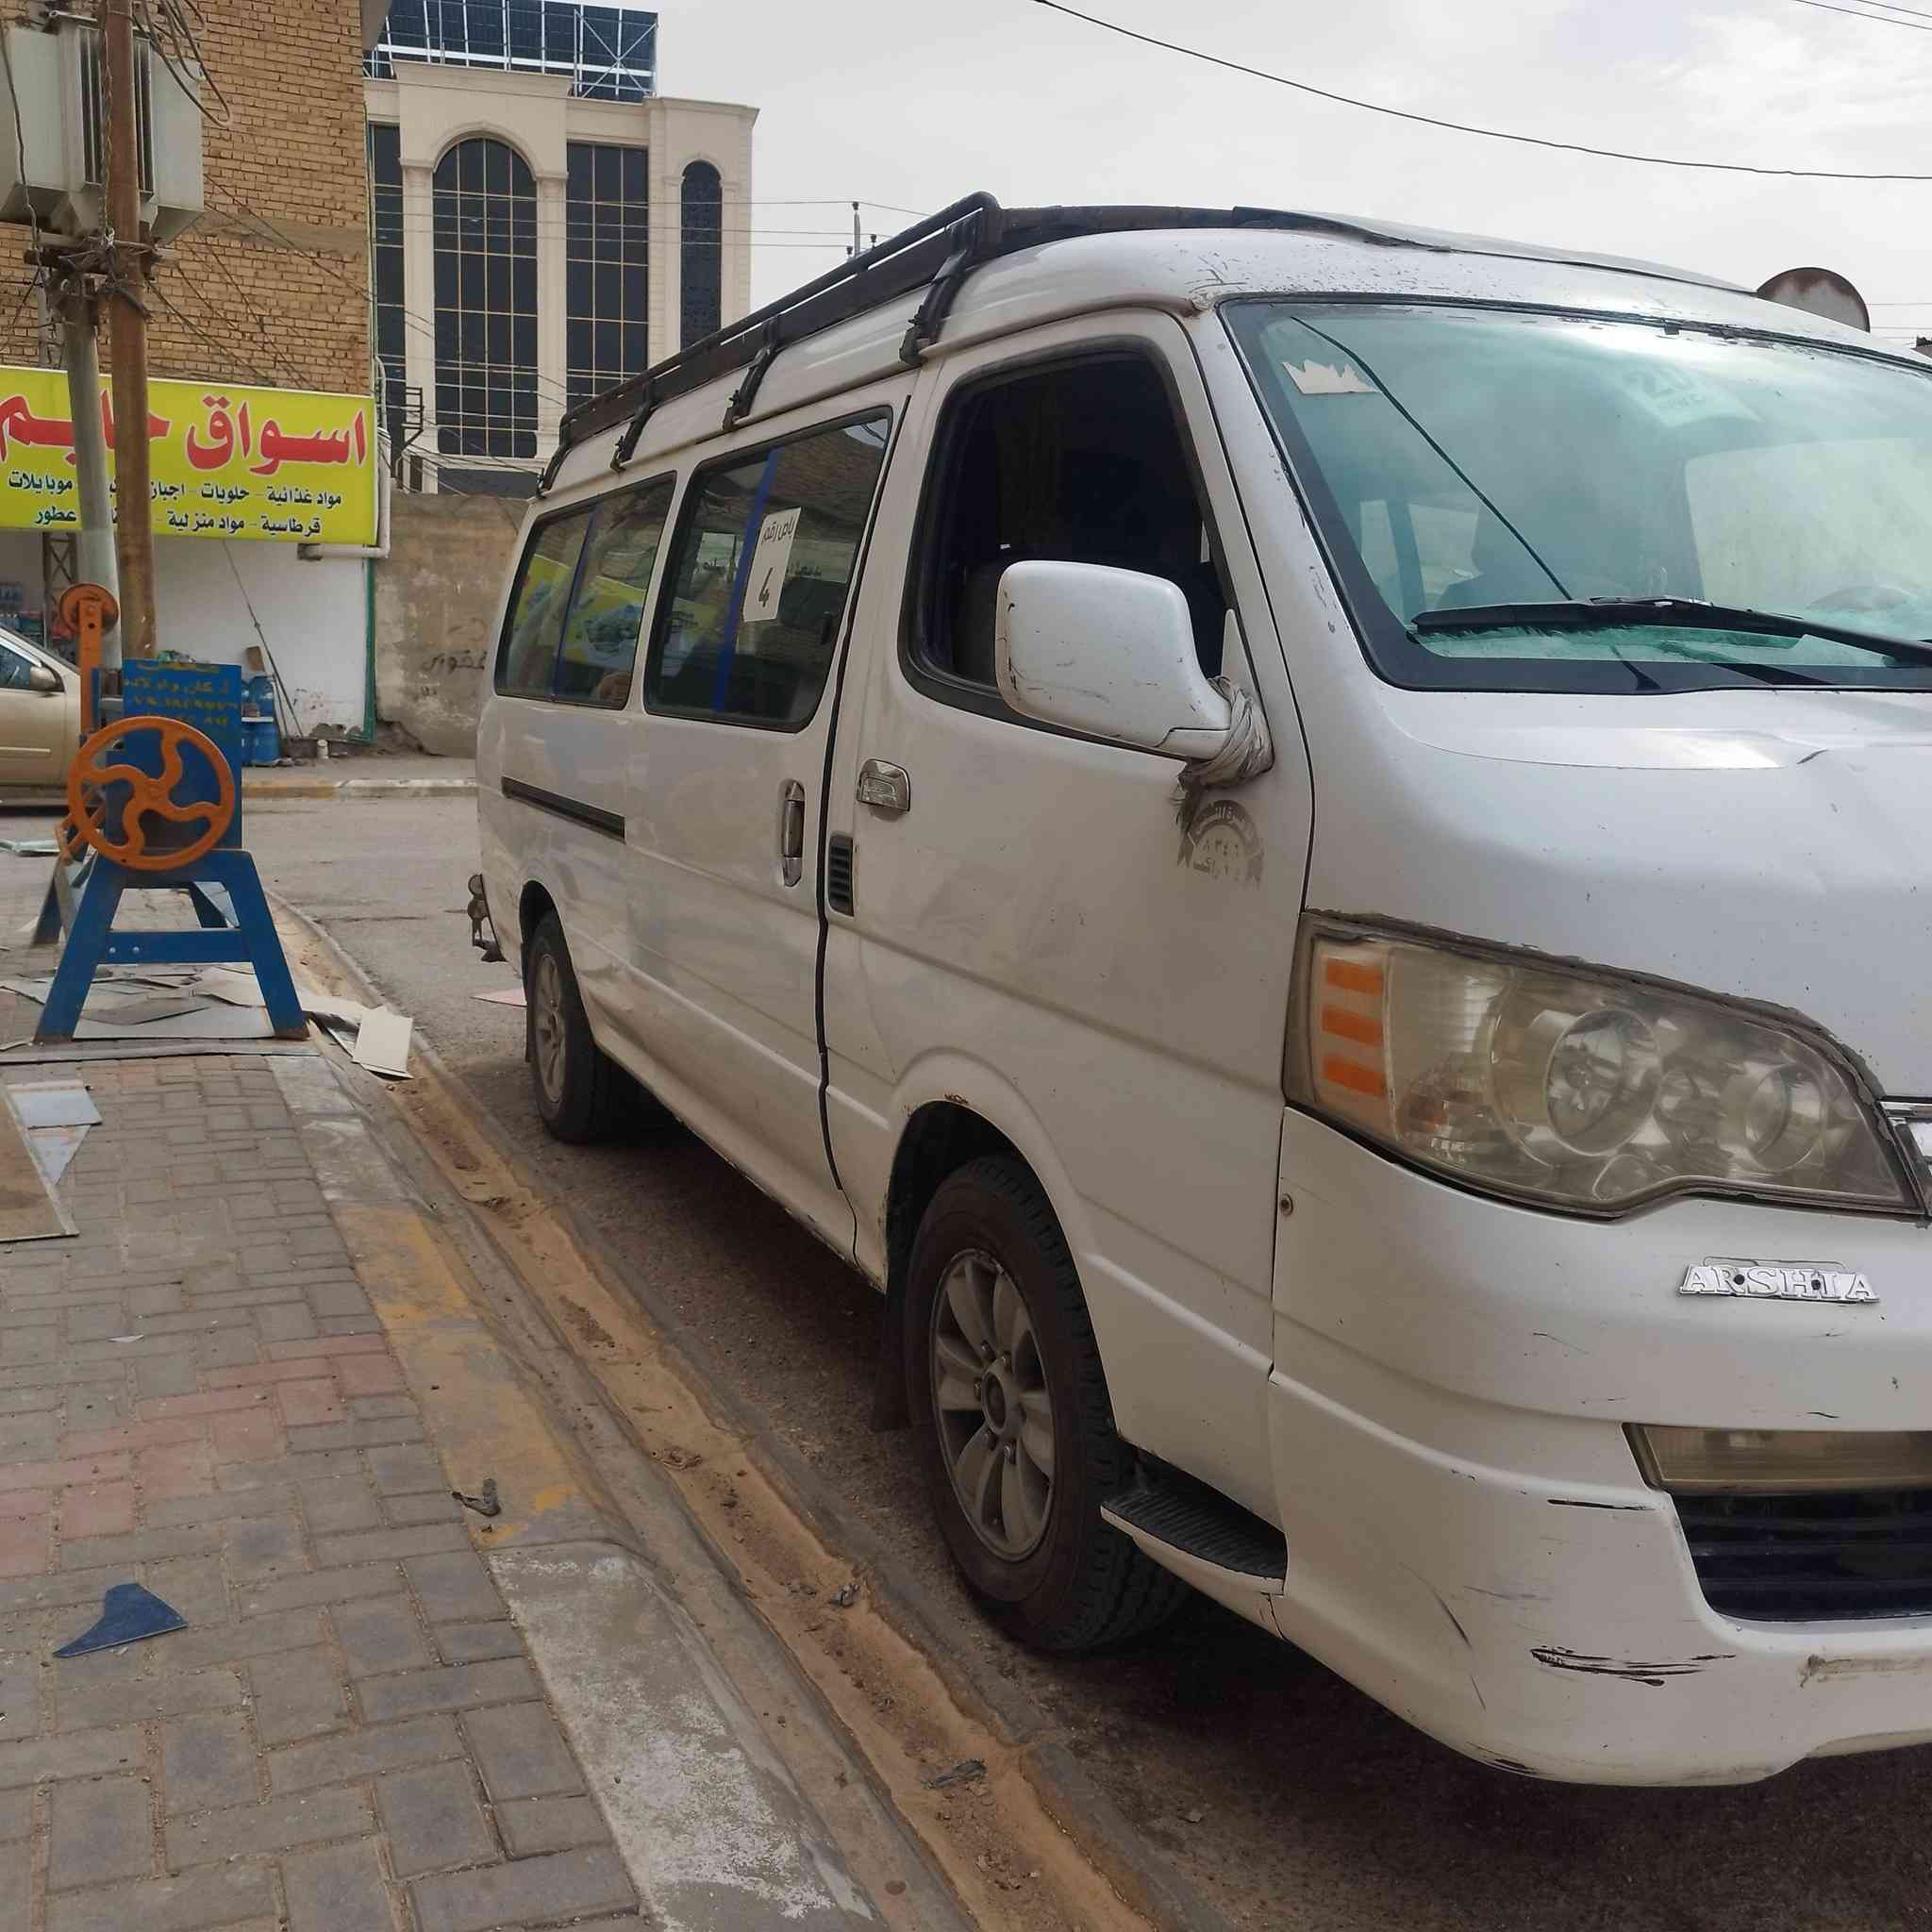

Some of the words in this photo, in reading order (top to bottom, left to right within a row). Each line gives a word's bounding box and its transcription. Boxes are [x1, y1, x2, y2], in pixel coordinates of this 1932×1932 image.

[185, 395, 367, 475] اسواق
[8, 470, 73, 495] موبايلات
[201, 482, 250, 505] حلويات
[317, 491, 341, 509] مواد
[34, 505, 77, 525] عطور
[219, 515, 245, 534] مواد
[260, 514, 321, 538] قرطاسية
[758, 566, 774, 608] 4
[1679, 1264, 1880, 1304] ARSHIA
